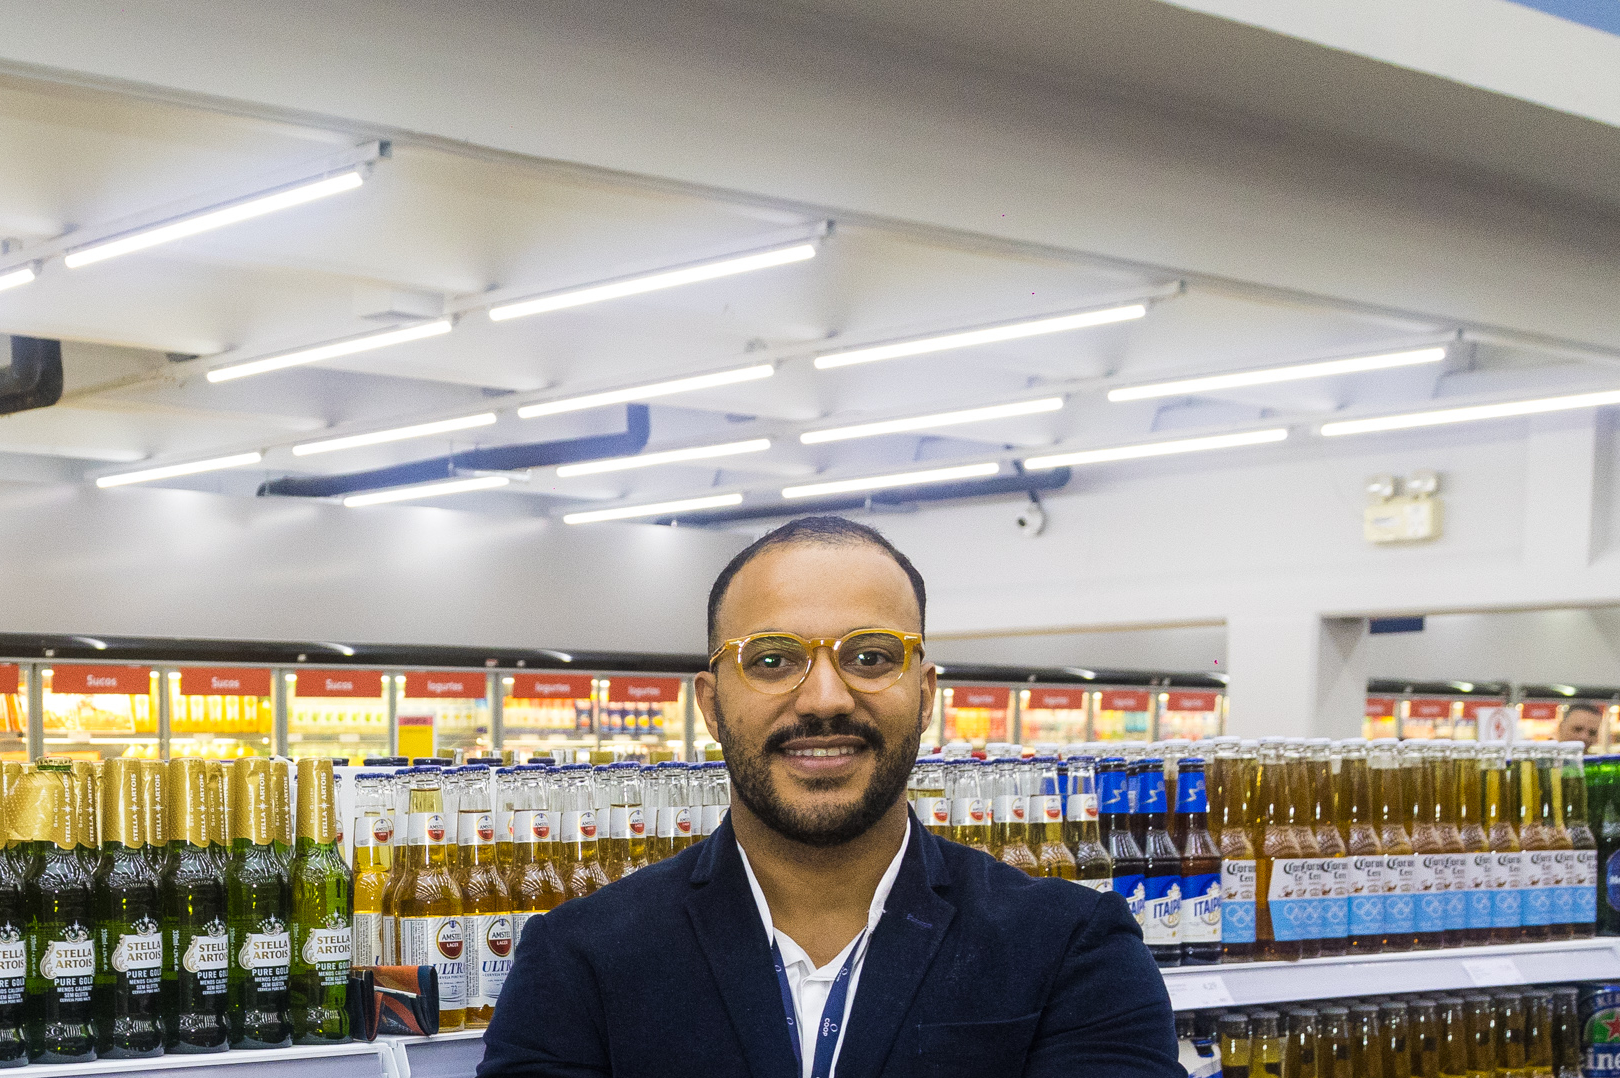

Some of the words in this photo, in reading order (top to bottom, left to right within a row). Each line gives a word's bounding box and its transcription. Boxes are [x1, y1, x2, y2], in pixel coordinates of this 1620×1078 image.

[86, 674, 118, 688] Sucos
[211, 676, 241, 689] Sucos
[325, 678, 353, 691] Sucos
[822, 1017, 831, 1037] COOP
